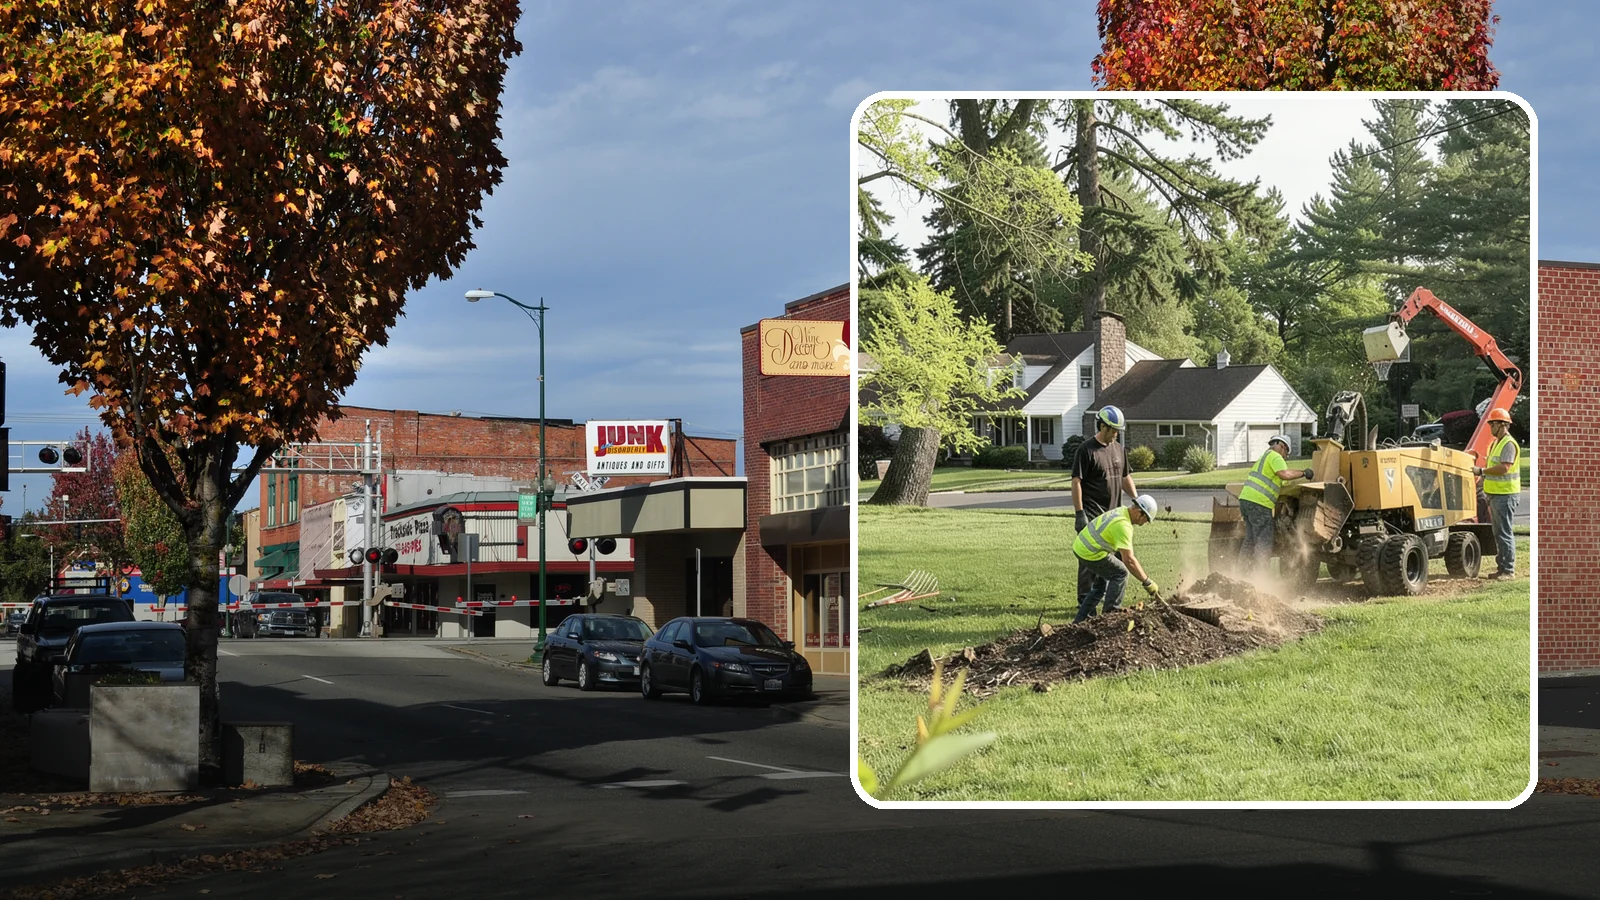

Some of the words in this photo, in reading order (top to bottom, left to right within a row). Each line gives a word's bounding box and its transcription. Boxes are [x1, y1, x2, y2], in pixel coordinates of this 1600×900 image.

[596, 425, 665, 457] JUNK
[607, 446, 645, 454] DISORDERLY
[597, 461, 628, 470] ANTIQUES
[631, 461, 644, 470] AND
[647, 461, 665, 470] GIFTS
[573, 473, 588, 491] RAIL
[352, 498, 365, 511] CRO
[390, 522, 413, 539] Trackside
[414, 519, 429, 535] Pizza
